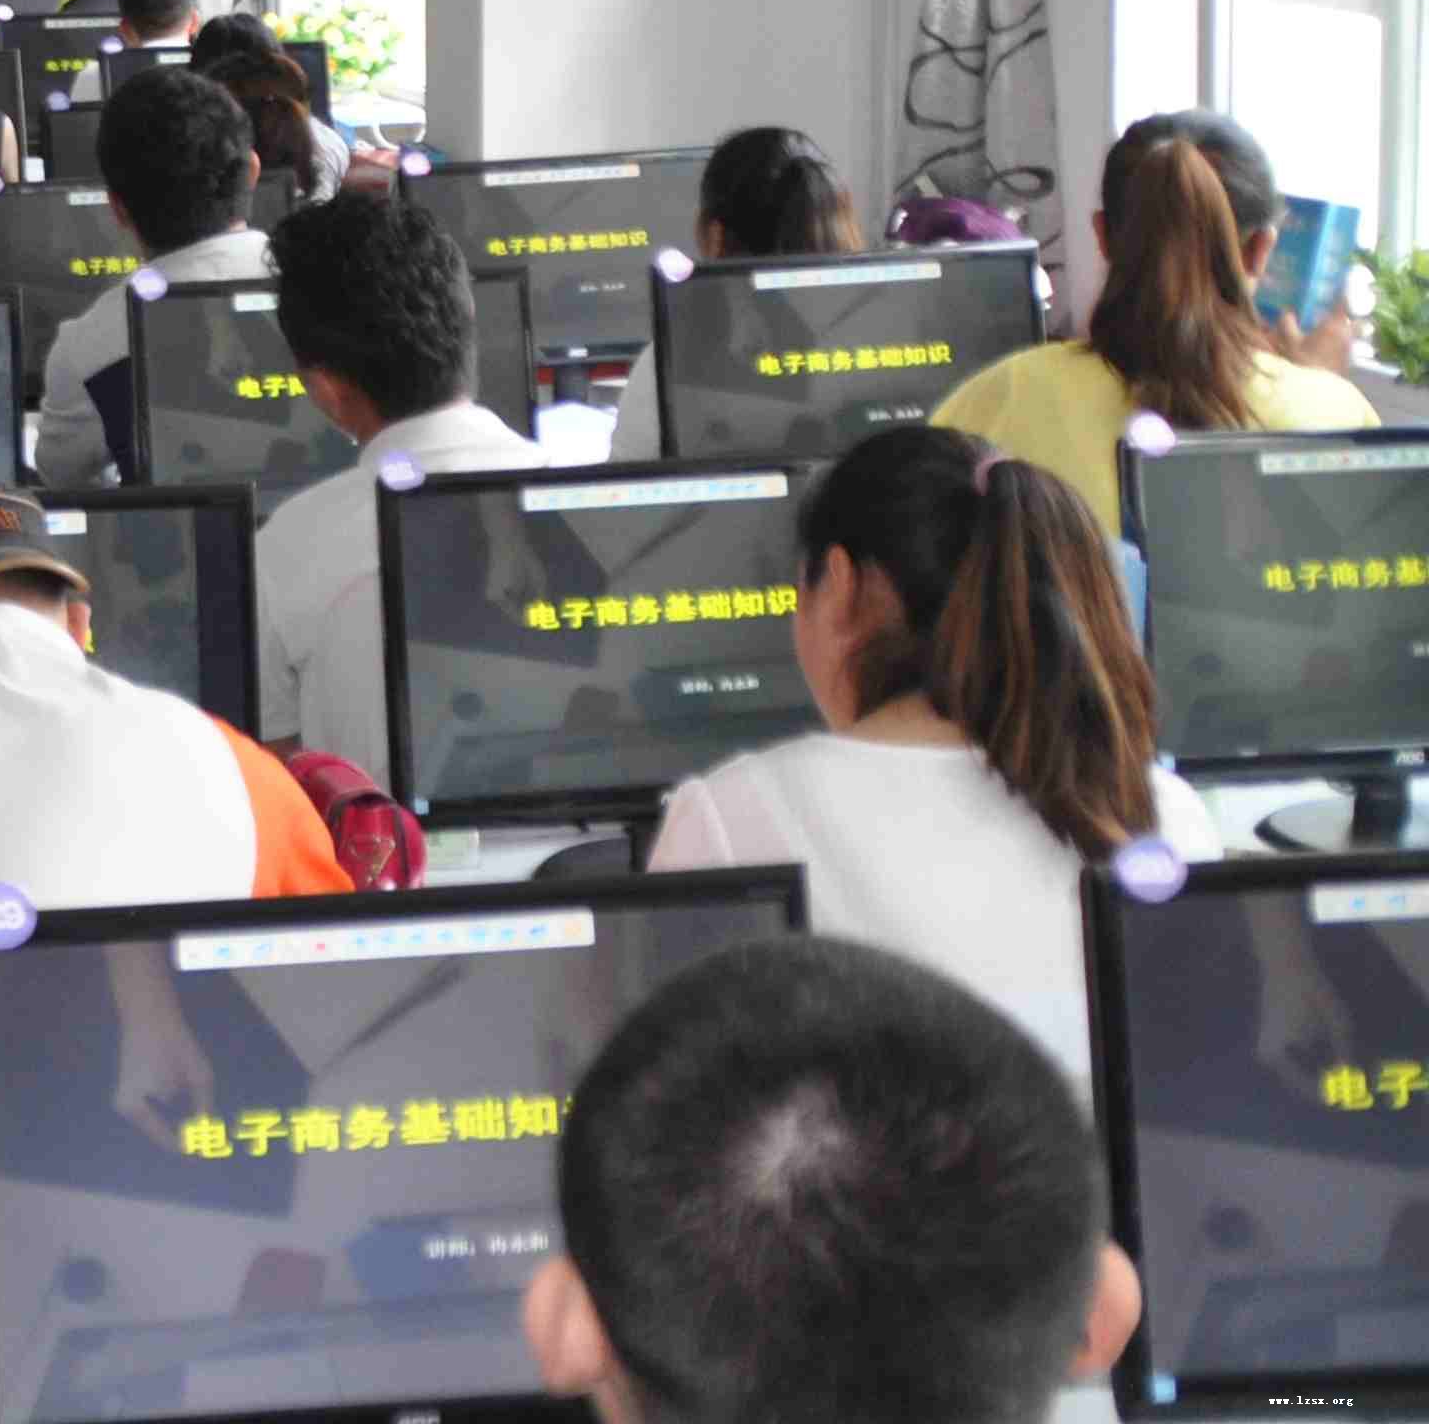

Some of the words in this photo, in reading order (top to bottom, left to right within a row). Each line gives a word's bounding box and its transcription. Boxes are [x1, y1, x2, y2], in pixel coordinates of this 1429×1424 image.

[486, 231, 649, 257] 电子商务基础知识
[757, 342, 954, 378] 电子商务基础知识
[526, 584, 799, 631] 电子商务基础知识
[184, 1097, 575, 1160] 电子商务基础知
